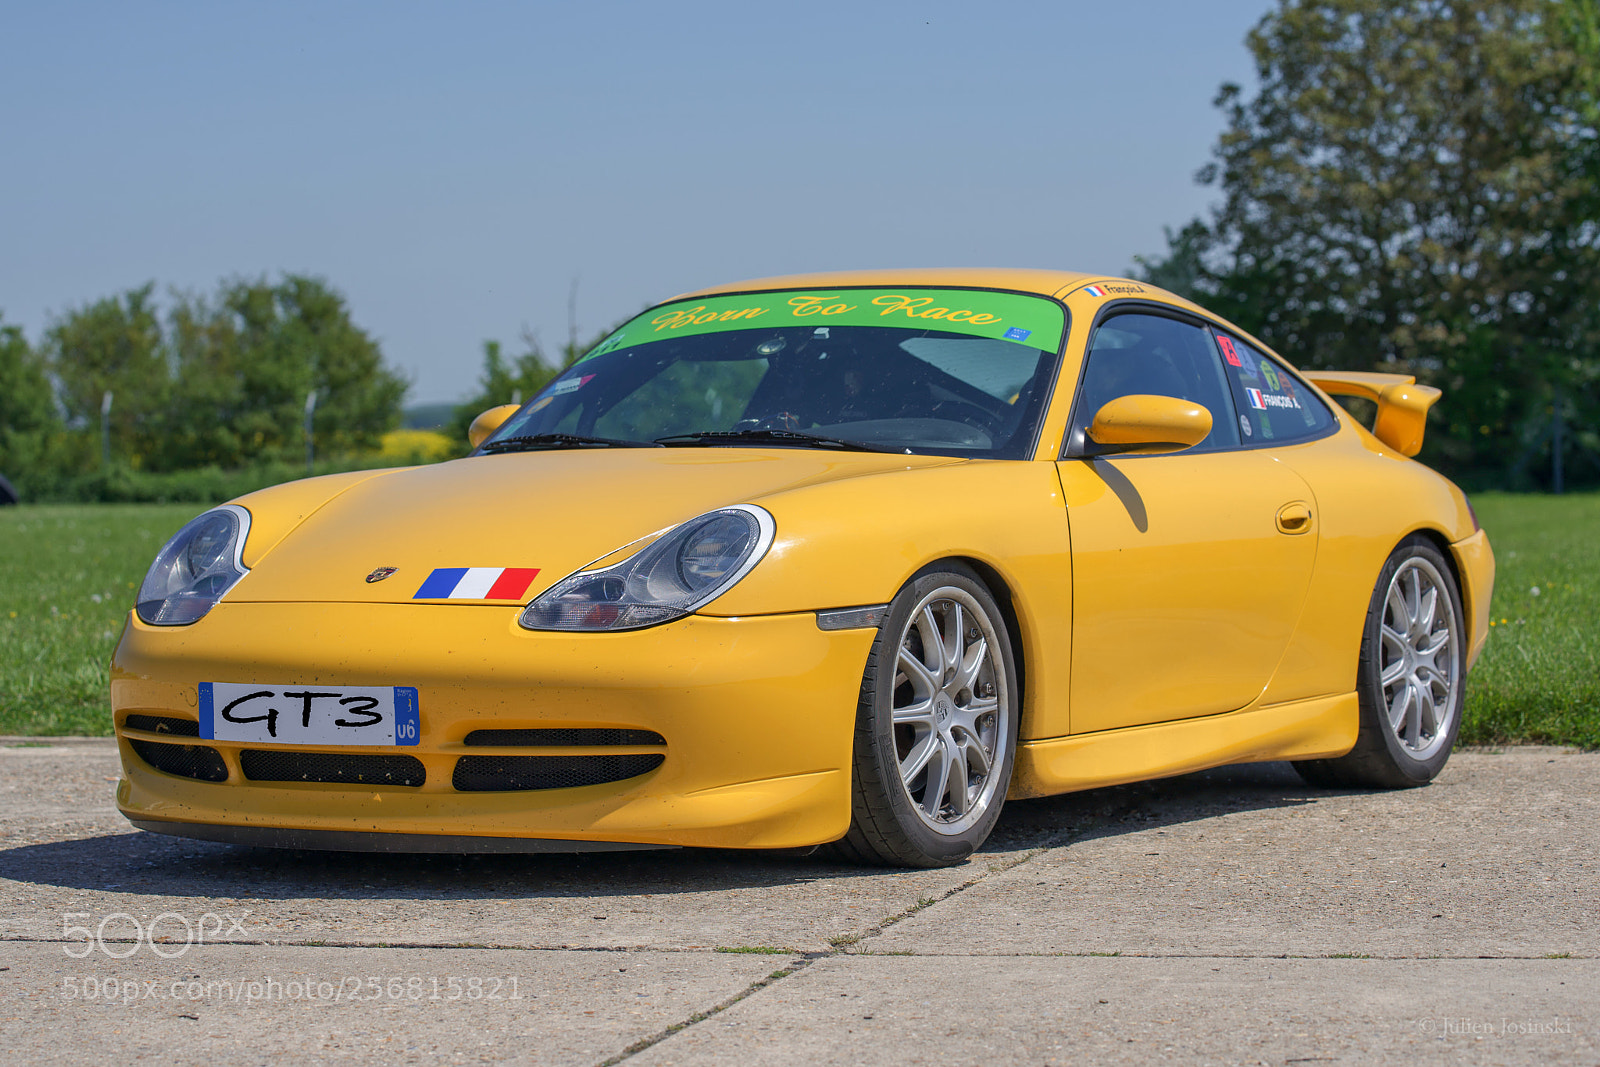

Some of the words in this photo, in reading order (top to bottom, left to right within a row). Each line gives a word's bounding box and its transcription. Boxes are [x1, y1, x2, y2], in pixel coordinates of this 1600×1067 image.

[651, 305, 769, 332] Born
[787, 295, 857, 318] To
[871, 293, 1002, 325] Race
[221, 690, 383, 738] GT3
